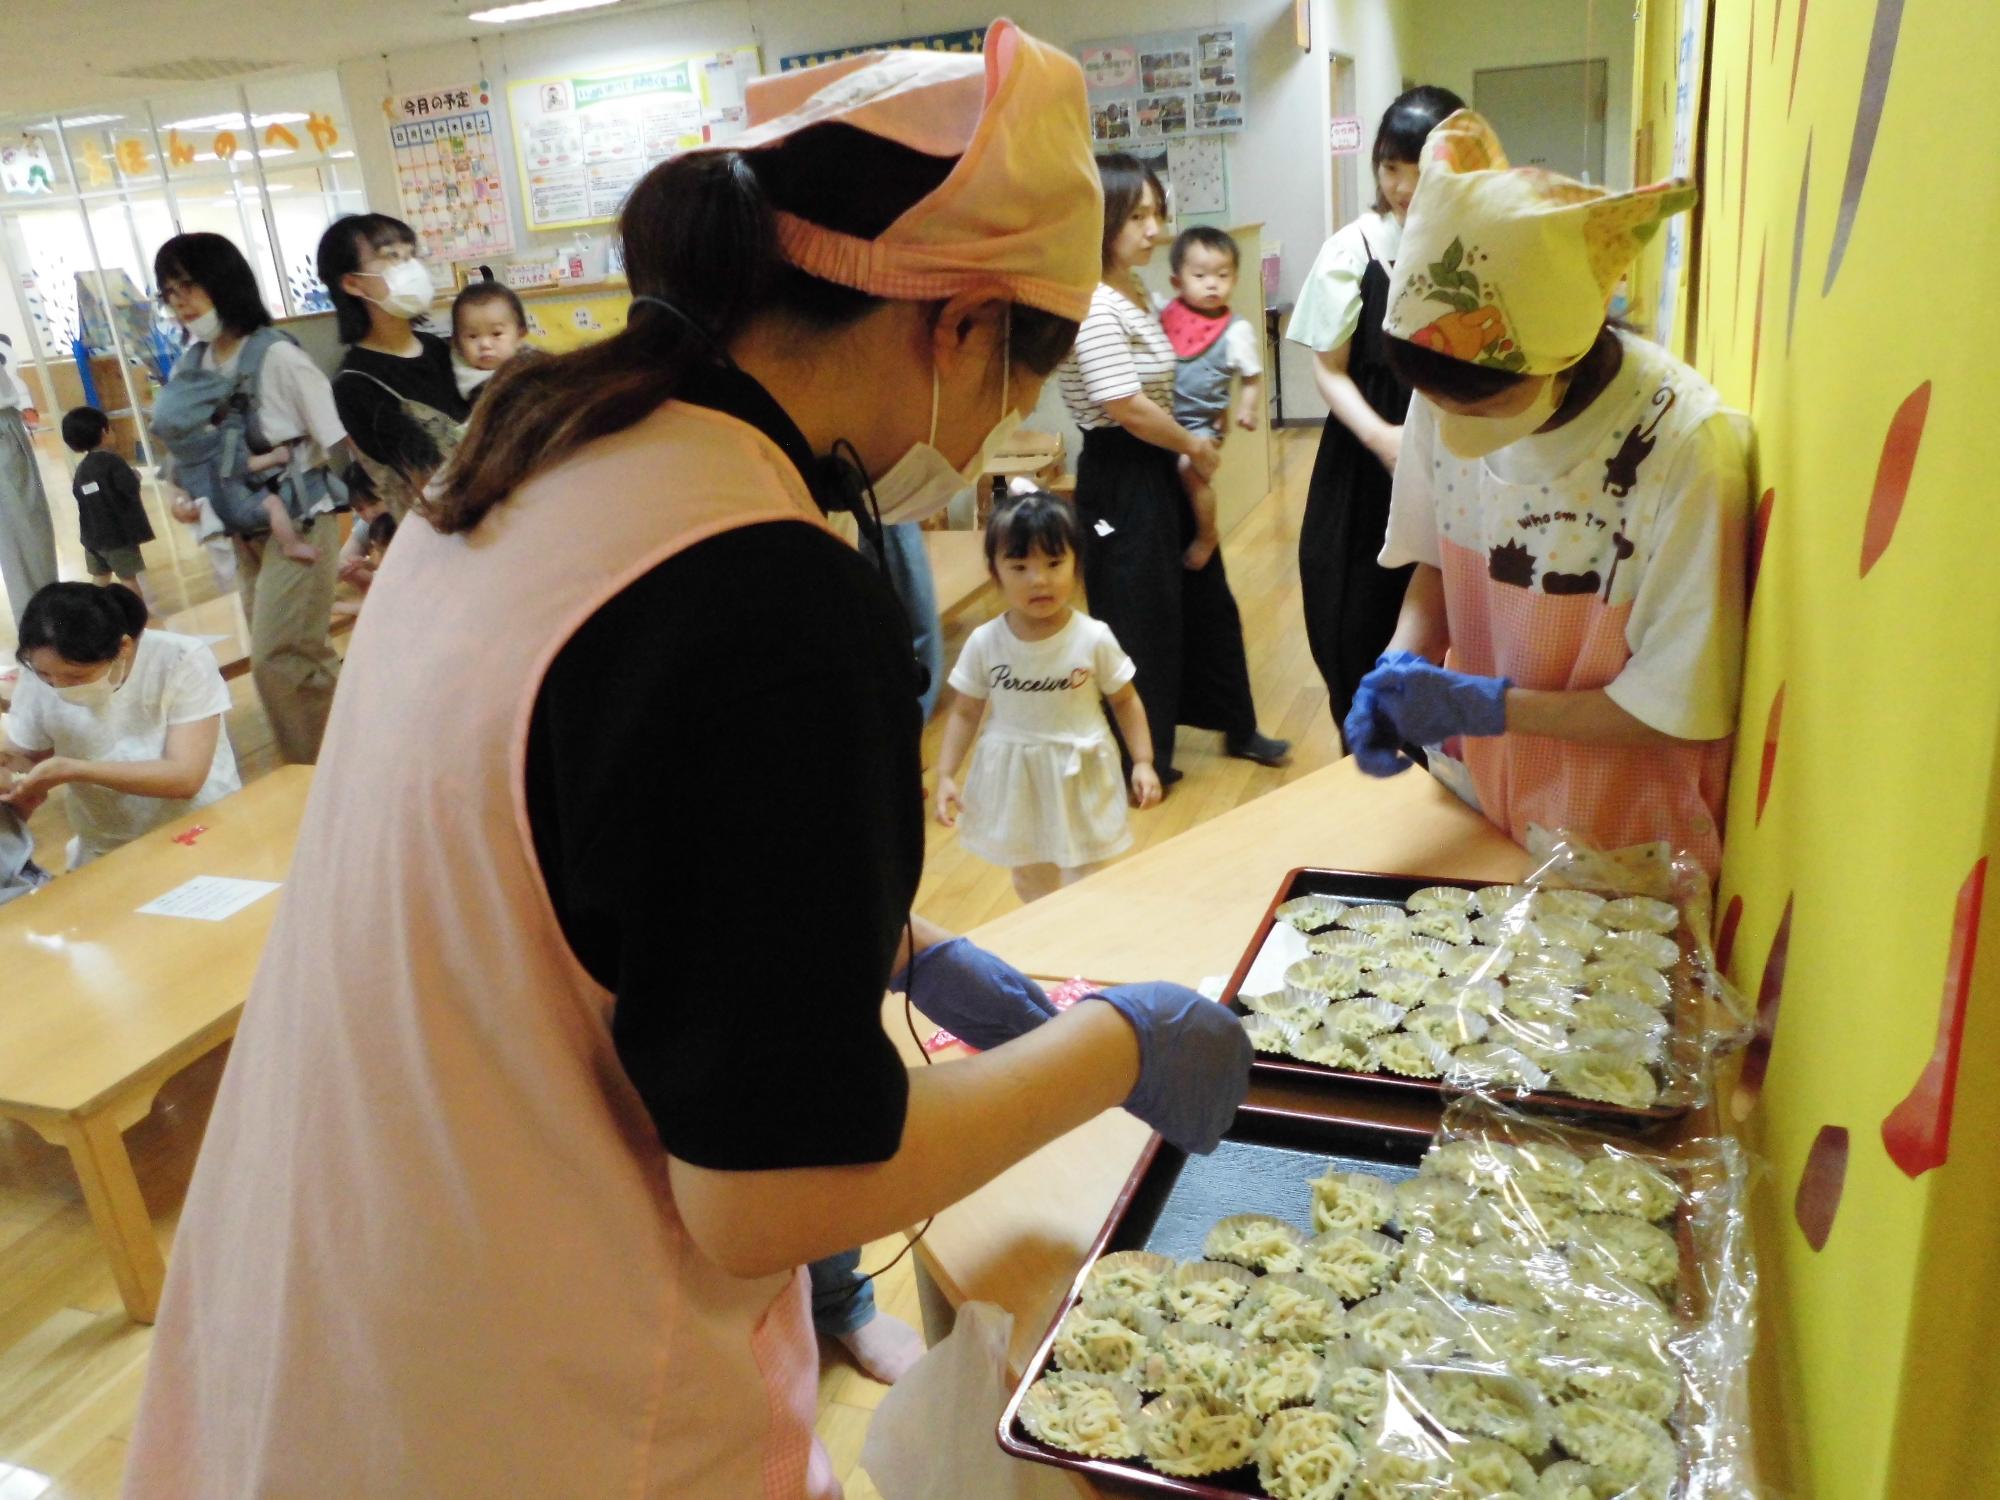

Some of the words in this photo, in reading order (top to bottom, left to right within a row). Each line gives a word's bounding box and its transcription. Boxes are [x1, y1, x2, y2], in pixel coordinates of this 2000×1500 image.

[404, 91, 470, 116] 今月の予定
[990, 664, 1071, 692] Perceive
